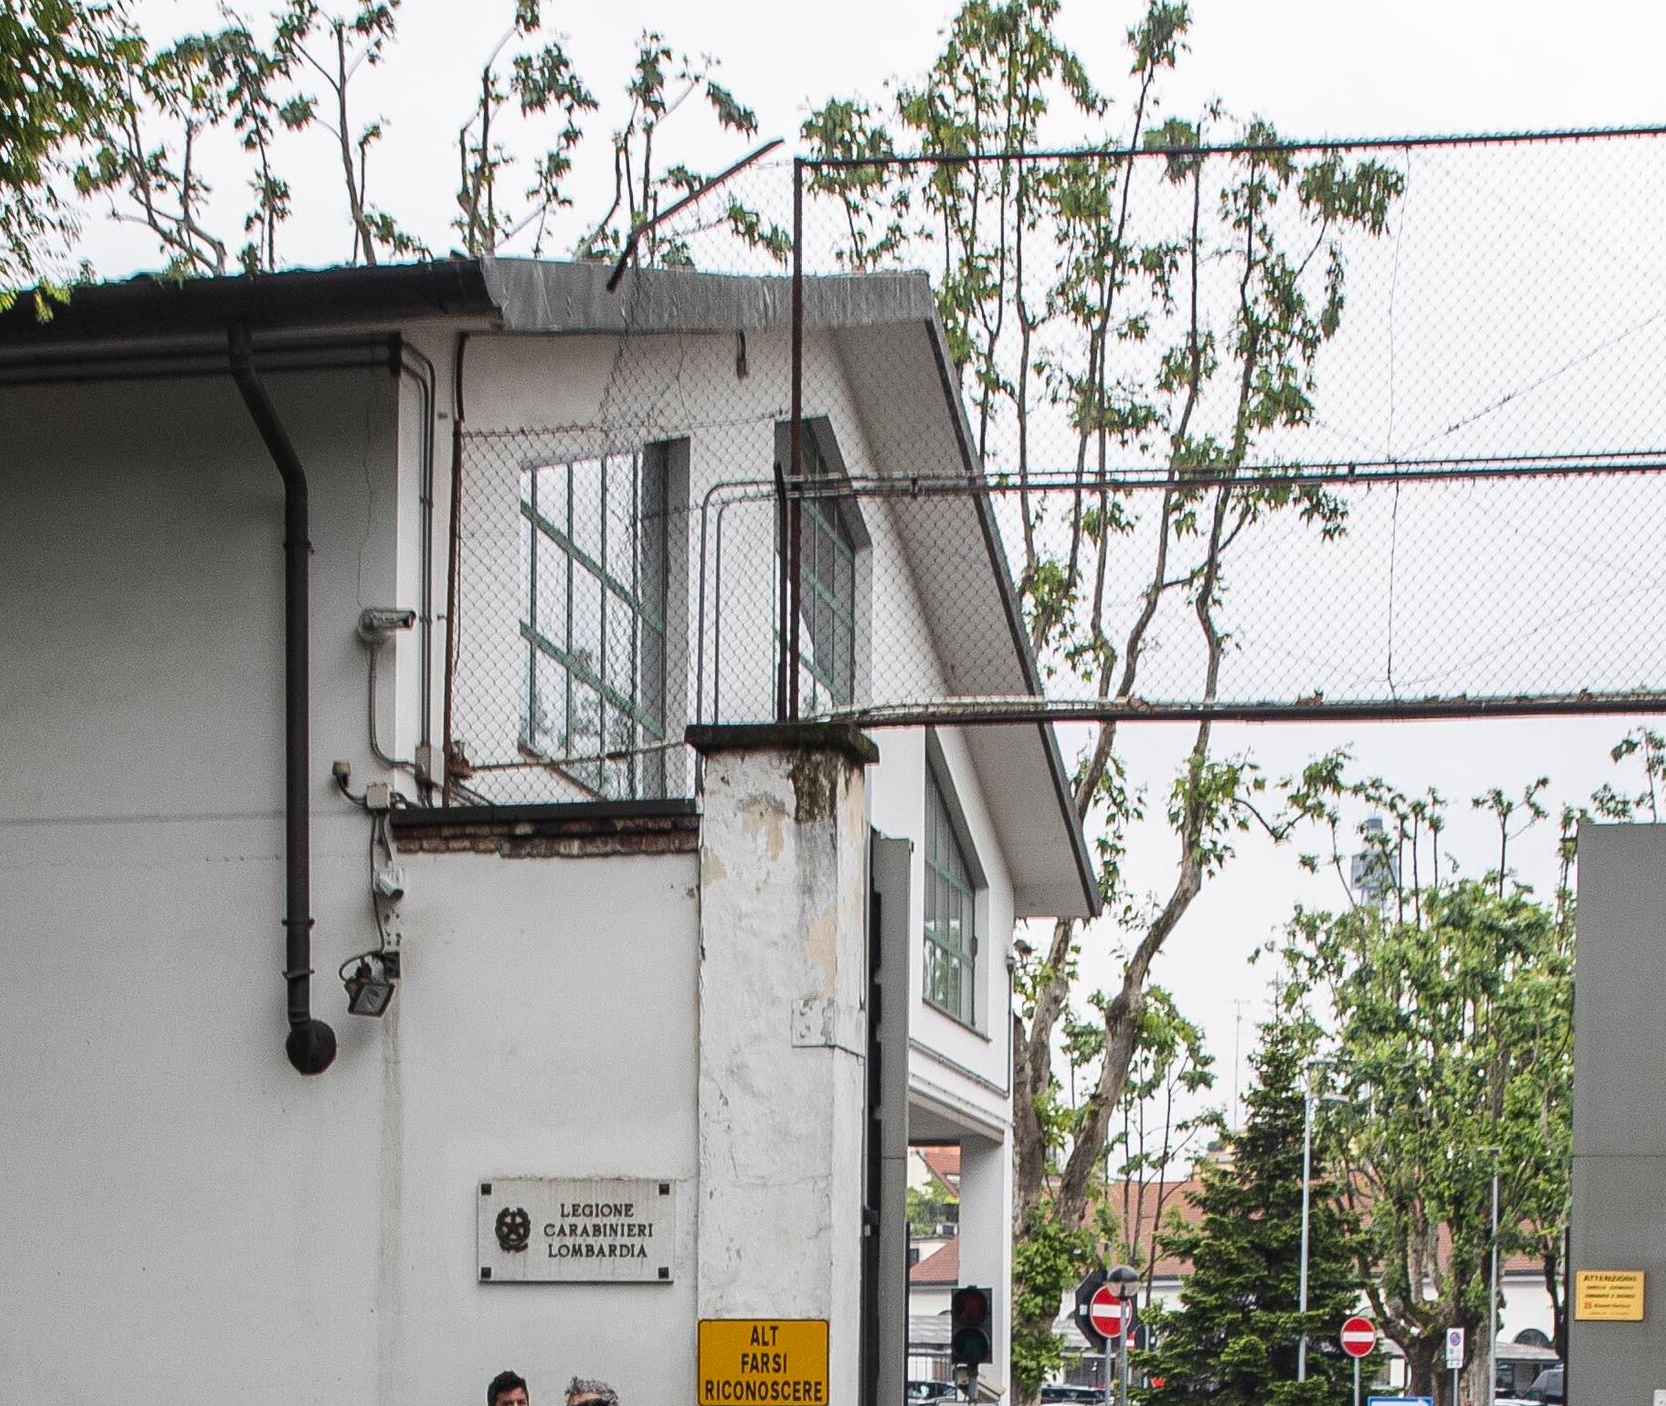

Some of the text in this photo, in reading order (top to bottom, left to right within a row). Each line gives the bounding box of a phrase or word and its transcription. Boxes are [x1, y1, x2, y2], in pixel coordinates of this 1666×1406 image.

[560, 1203, 634, 1218] LEGIONE
[543, 1223, 653, 1237] CARABINIERI
[548, 1243, 648, 1258] LOMBARDIA
[749, 1325, 779, 1346] ALT
[740, 1352, 788, 1374] FARSI
[704, 1379, 823, 1402] RICONOSCERE
